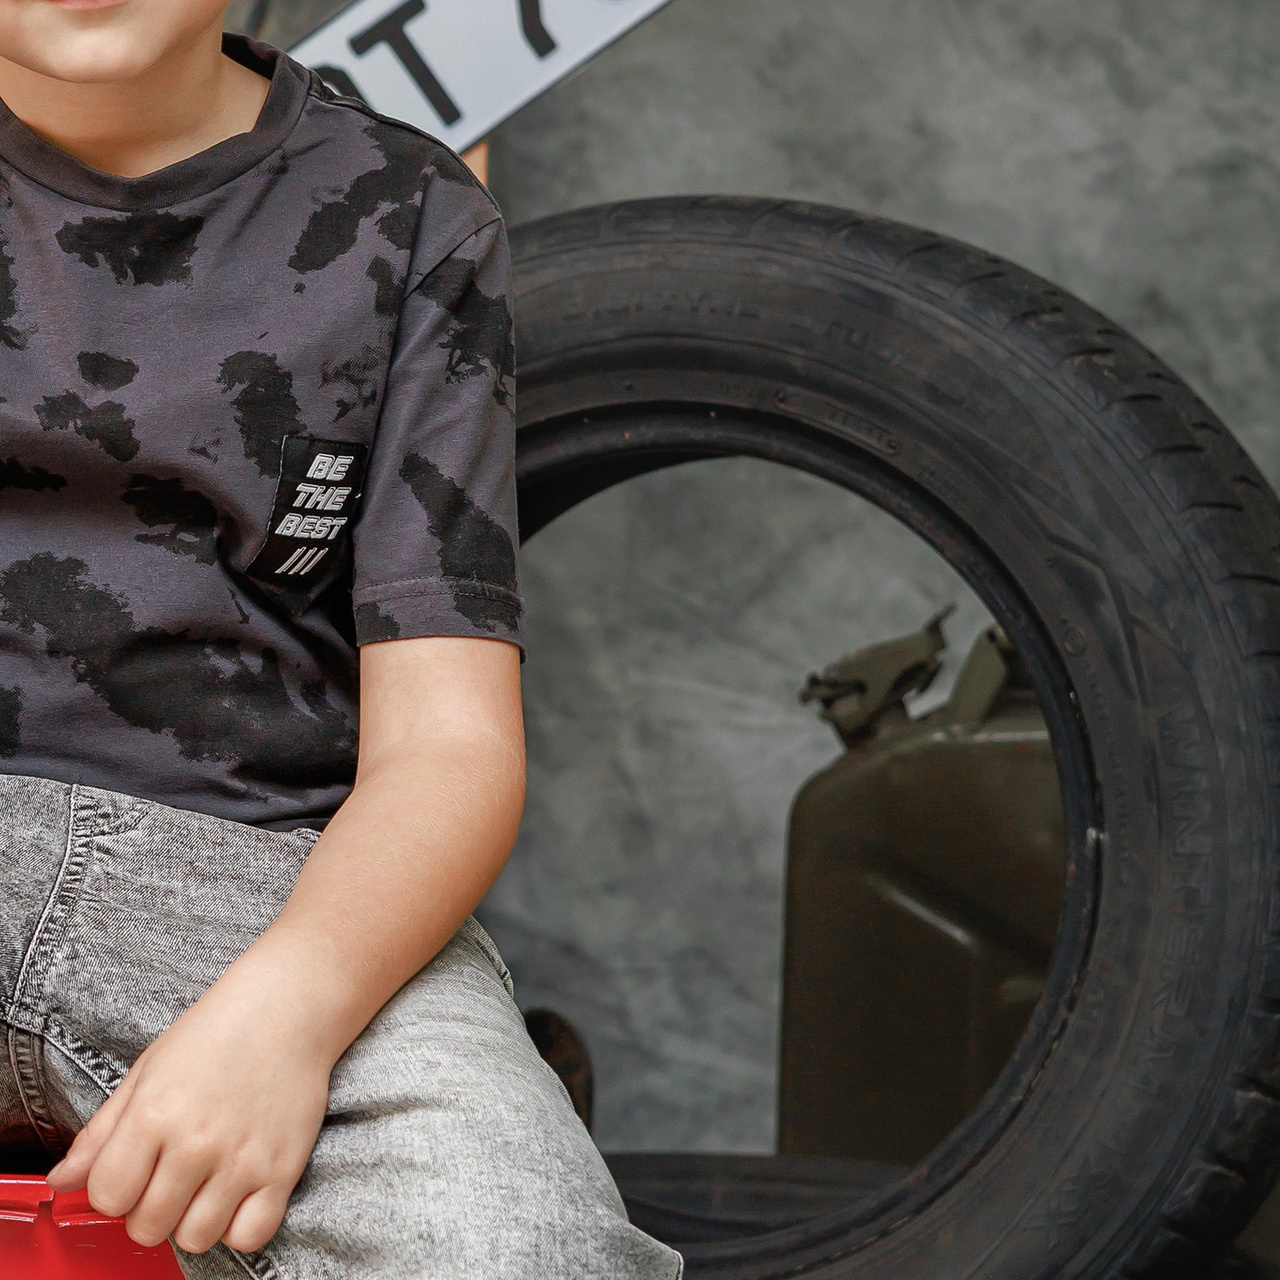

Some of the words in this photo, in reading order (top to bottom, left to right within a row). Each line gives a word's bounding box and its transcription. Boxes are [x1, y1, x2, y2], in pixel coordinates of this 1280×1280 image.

[306, 453, 355, 481] BE
[292, 482, 352, 511] THE
[274, 512, 348, 540] BEST
